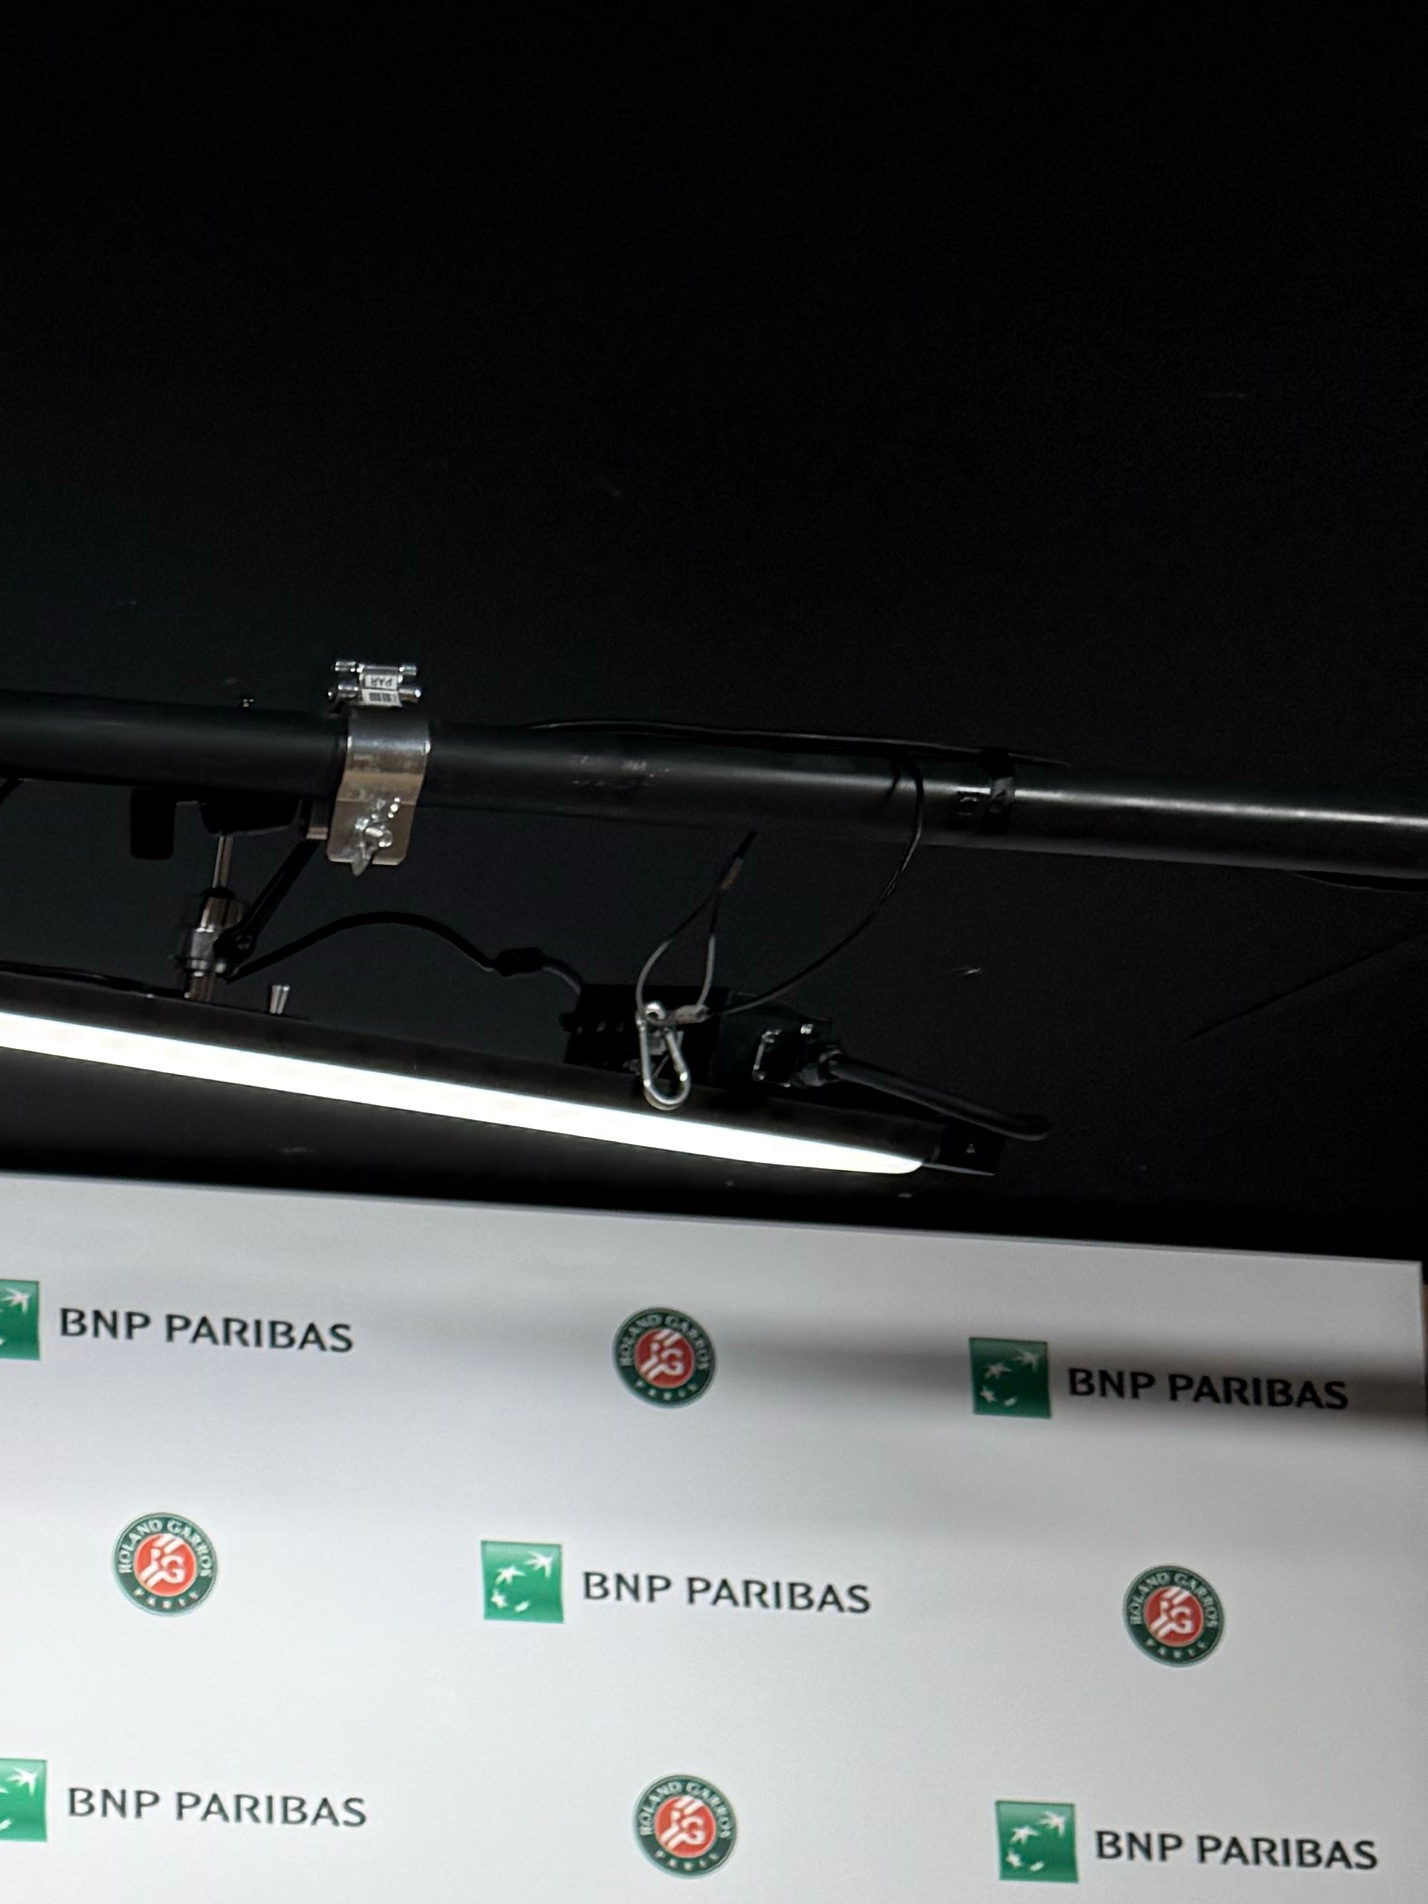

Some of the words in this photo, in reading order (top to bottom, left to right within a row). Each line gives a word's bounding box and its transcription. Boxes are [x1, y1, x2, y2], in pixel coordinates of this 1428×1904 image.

[60, 1307, 151, 1340] BNP
[165, 1313, 353, 1353] PARIBAS
[1068, 1367, 1155, 1402] BNP
[1168, 1373, 1349, 1412] PARIBAS
[584, 1571, 672, 1603] BNP
[687, 1576, 871, 1614] PARIBAS
[69, 1787, 160, 1818] BNP
[176, 1791, 366, 1827] PARIBAS
[1095, 1830, 1183, 1862] BNP
[1197, 1834, 1378, 1870] PARIBAS
